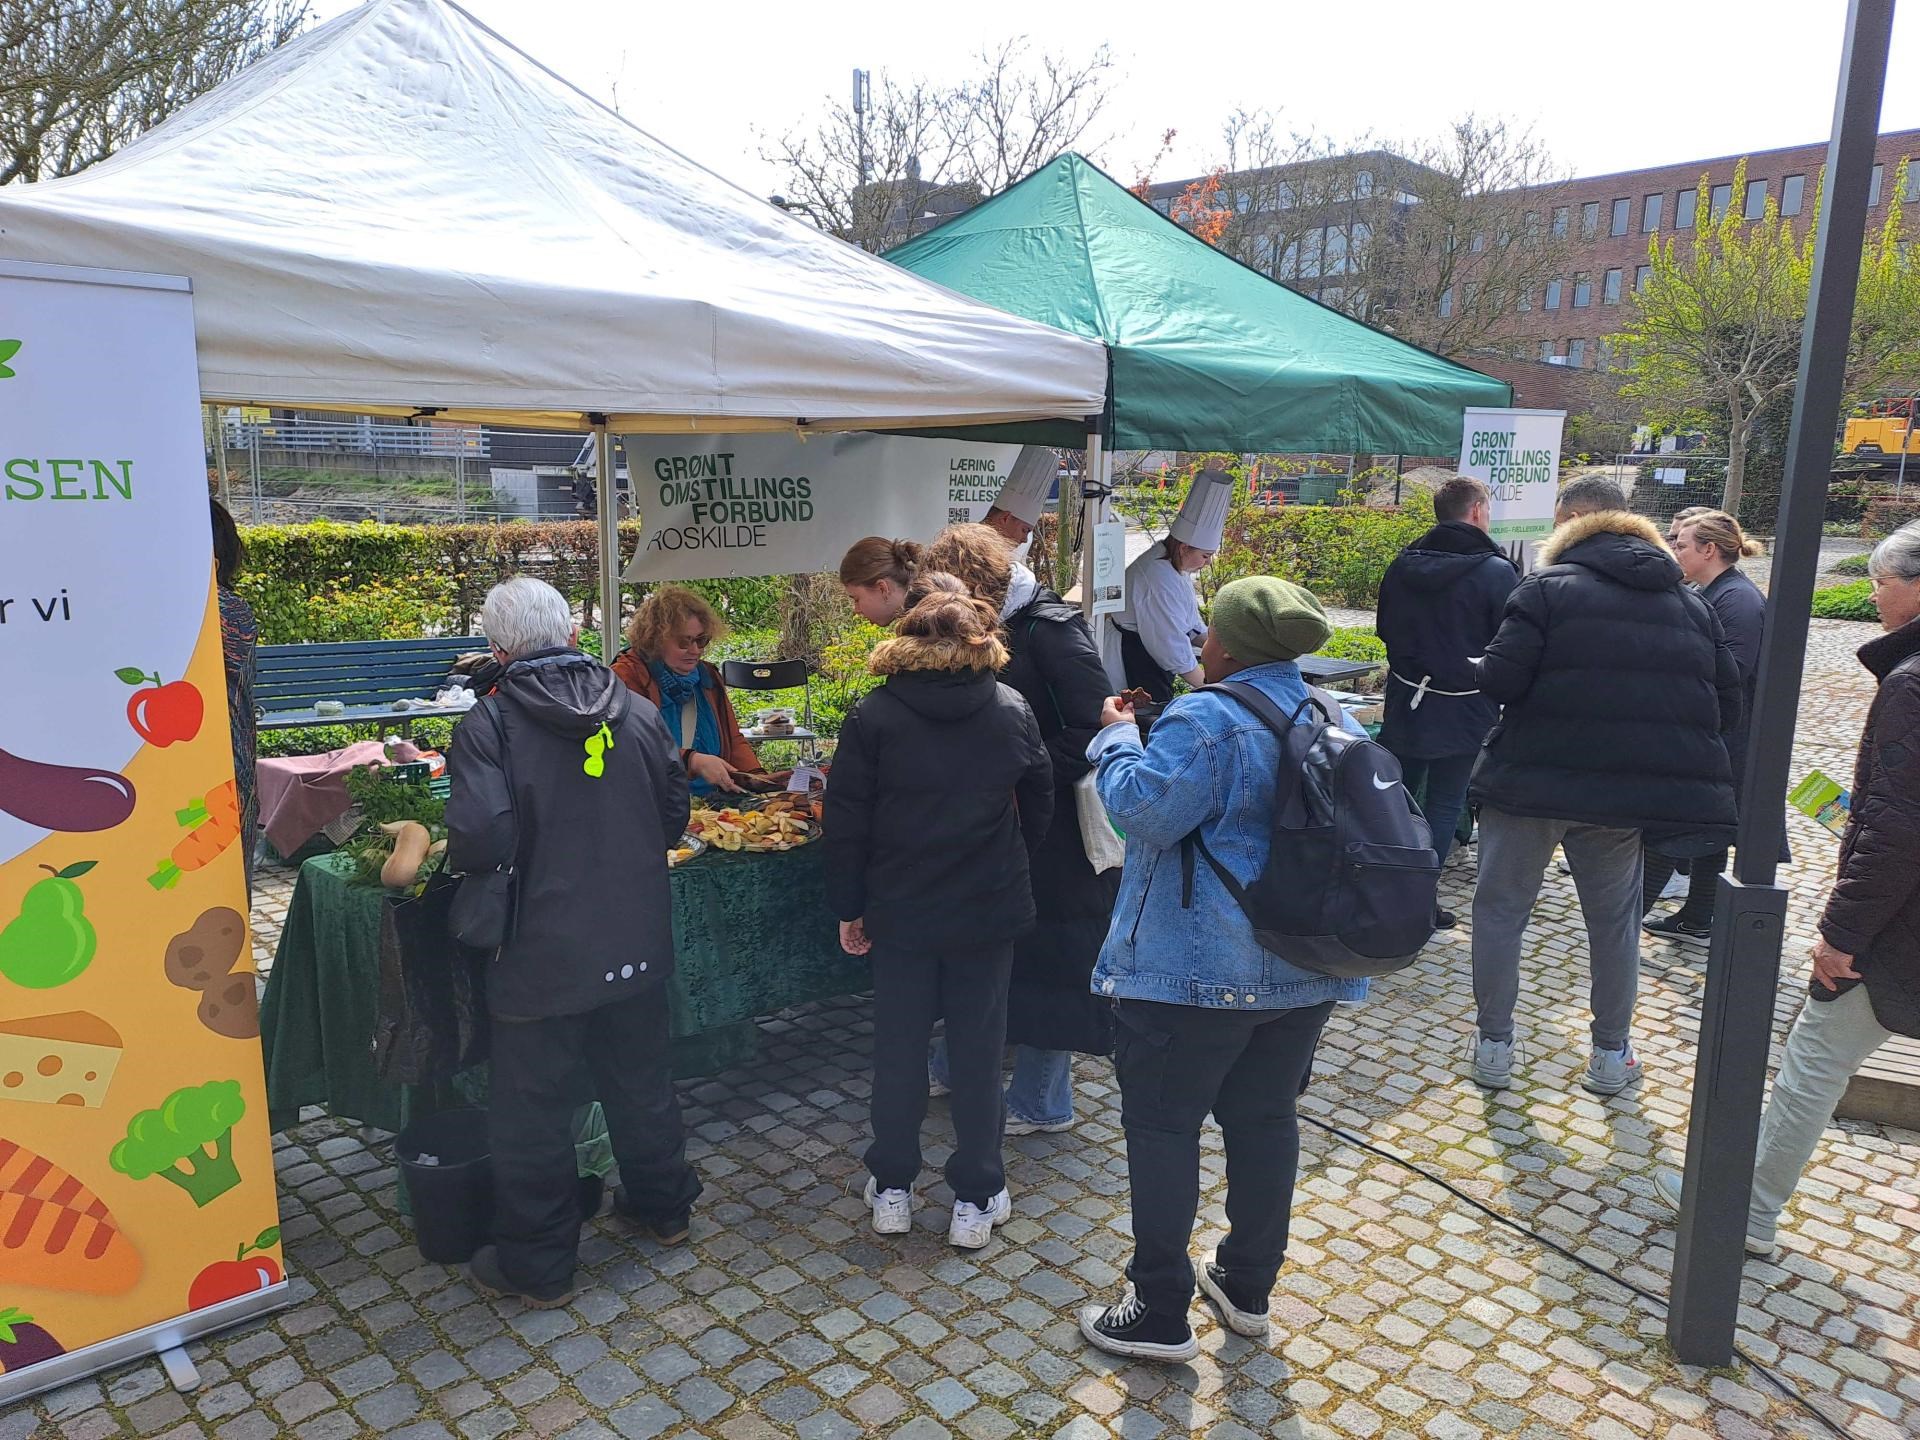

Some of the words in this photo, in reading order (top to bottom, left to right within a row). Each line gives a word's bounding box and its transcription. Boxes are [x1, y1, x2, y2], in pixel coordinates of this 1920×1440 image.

[1471, 431, 1516, 448] GRØNT
[654, 453, 735, 482] GRØNT
[950, 458, 995, 472] LÆRING
[1469, 450, 1551, 467] OMSTILLINGS
[4, 458, 133, 500] SEN
[949, 474, 1007, 488] HANDLING
[1490, 467, 1550, 484] FORBUND
[659, 476, 812, 507] OMSTILLINGS
[692, 500, 814, 525] FORBUND
[647, 525, 767, 551] ROSKILDE
[31, 588, 70, 622] vi
